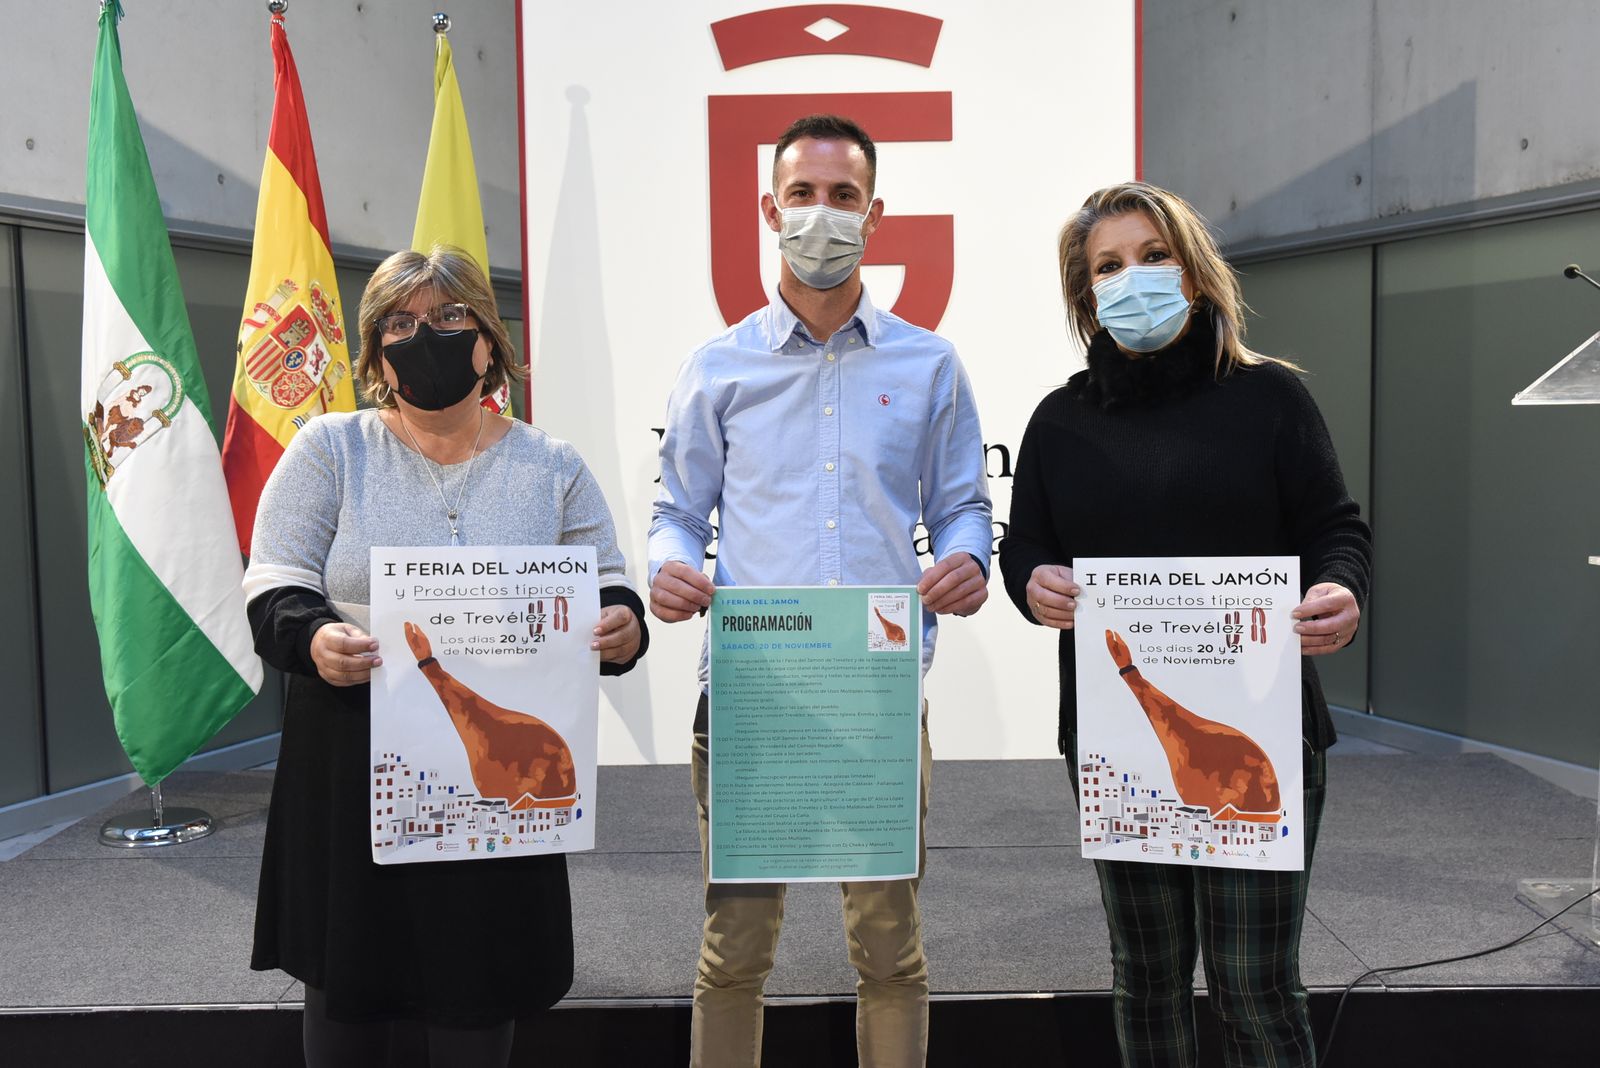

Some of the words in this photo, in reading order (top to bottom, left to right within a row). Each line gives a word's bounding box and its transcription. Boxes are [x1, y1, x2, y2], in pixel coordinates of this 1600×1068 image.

[384, 563, 396, 576] I
[406, 562, 465, 576] FERIA
[473, 562, 509, 575] DEL
[516, 557, 588, 575] JAMÓN
[1086, 573, 1097, 586] I
[1106, 573, 1162, 586] FERIA
[1169, 573, 1205, 586] DEL
[1212, 568, 1288, 586] JAMÓN
[395, 588, 405, 600] y
[414, 585, 508, 597] Productos
[515, 584, 575, 598] típicos
[770, 597, 800, 605] JAMÓN
[1096, 597, 1106, 608] y
[1113, 594, 1205, 606] Productos
[1211, 594, 1273, 609] típicos
[430, 612, 455, 625] de
[463, 611, 547, 625] Trevélez
[722, 612, 812, 632] PROGRAMACIÓN
[1129, 621, 1153, 634] de
[1161, 620, 1244, 634] Trevélez
[440, 635, 464, 644] Los
[500, 634, 516, 644] 20
[521, 637, 529, 645] y
[533, 634, 546, 643] 21
[443, 647, 460, 656] de
[465, 646, 538, 656] Noviembre
[1139, 644, 1163, 653] Los
[1197, 644, 1214, 653] 20
[1218, 647, 1226, 655] y
[1230, 644, 1243, 653] 21
[1142, 655, 1159, 665] de
[1163, 655, 1236, 665] Noviembre
